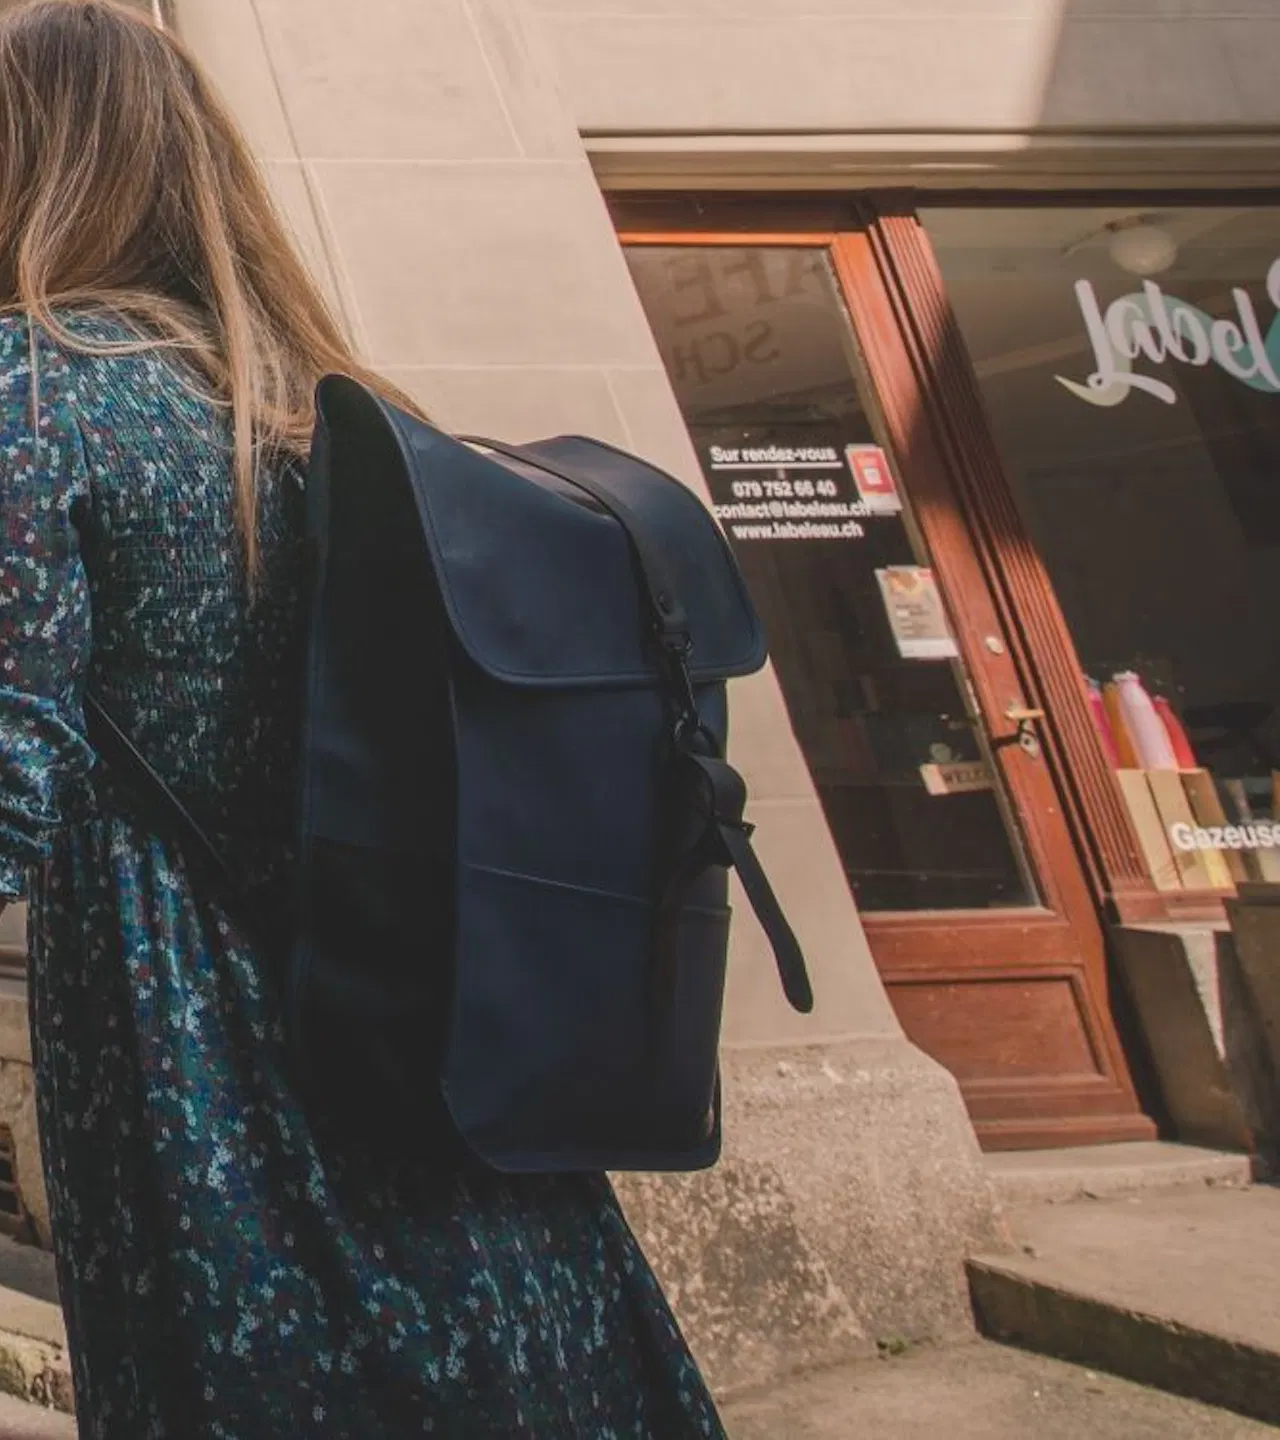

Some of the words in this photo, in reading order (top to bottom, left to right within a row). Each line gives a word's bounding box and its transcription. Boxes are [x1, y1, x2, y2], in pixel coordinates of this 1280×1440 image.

[1074, 259, 1280, 405] Label
[710, 446, 739, 462] Sur
[742, 445, 838, 461] rendez-vous
